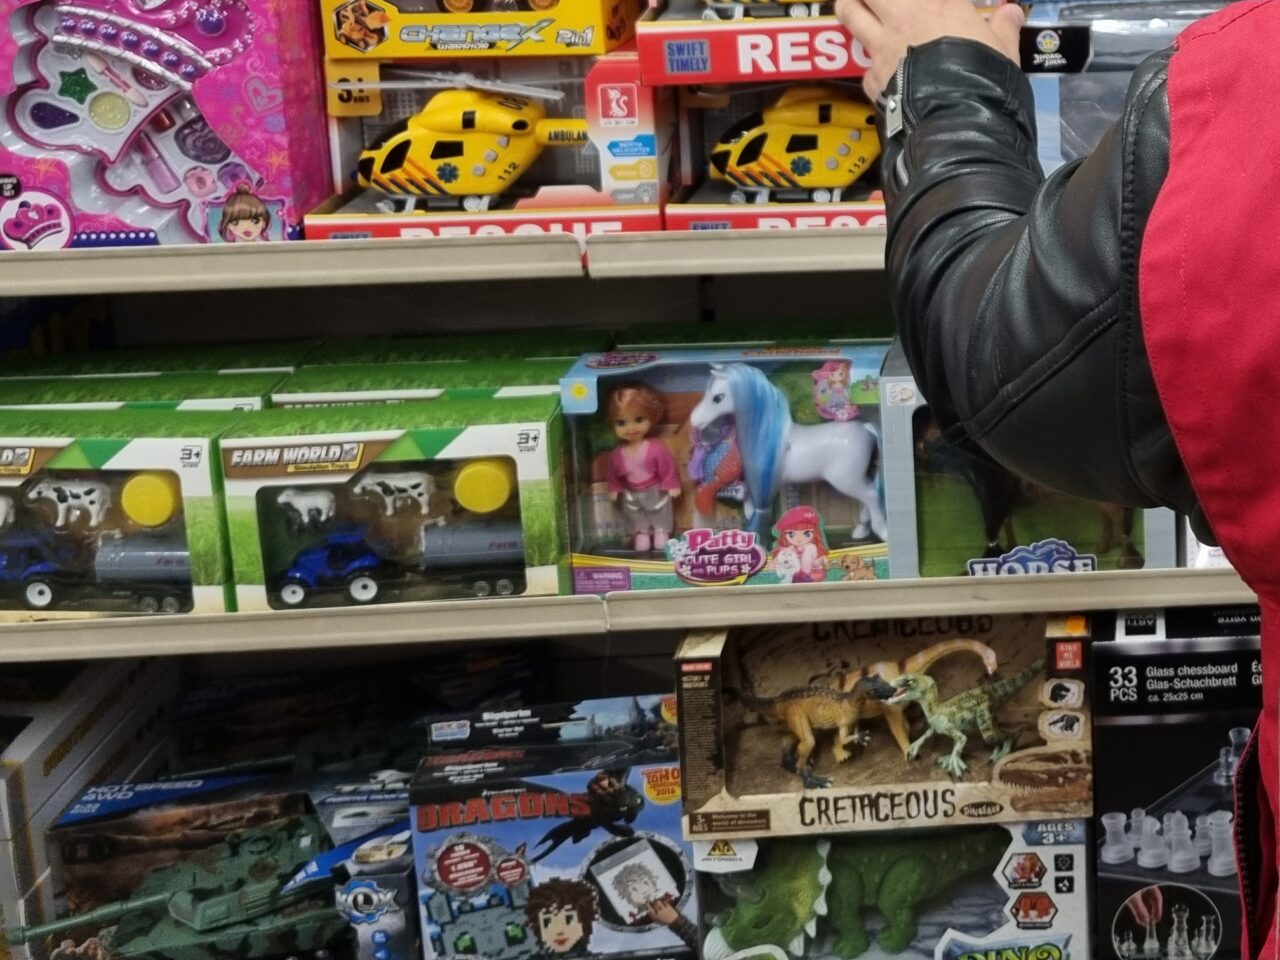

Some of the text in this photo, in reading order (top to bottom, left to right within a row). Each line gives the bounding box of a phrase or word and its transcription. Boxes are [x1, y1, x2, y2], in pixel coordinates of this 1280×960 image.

[666, 41, 706, 58] SWIFT
[736, 29, 873, 75] RES
[668, 55, 710, 74] TIMELY
[547, 130, 588, 141] AMBULAN
[497, 160, 520, 182] 112
[847, 155, 869, 175] 112
[517, 431, 540, 446] 3+
[180, 448, 202, 463] 3+
[231, 443, 342, 466] FARM WORLD
[686, 529, 756, 552] Patty
[684, 552, 756, 565] CUTE GIRL
[706, 566, 739, 577] PUPS
[1109, 665, 1138, 688] 33
[1146, 666, 1175, 678] Glass
[1177, 662, 1239, 676] chessboard
[1146, 675, 1237, 690] Glas-Schachbrett
[1109, 688, 1138, 702] PCS
[1148, 692, 1204, 702] ca. 25x25 cm
[416, 791, 592, 832] DRAGONS
[799, 788, 957, 827] CRETACEOUS
[1041, 832, 1067, 844] 3+
